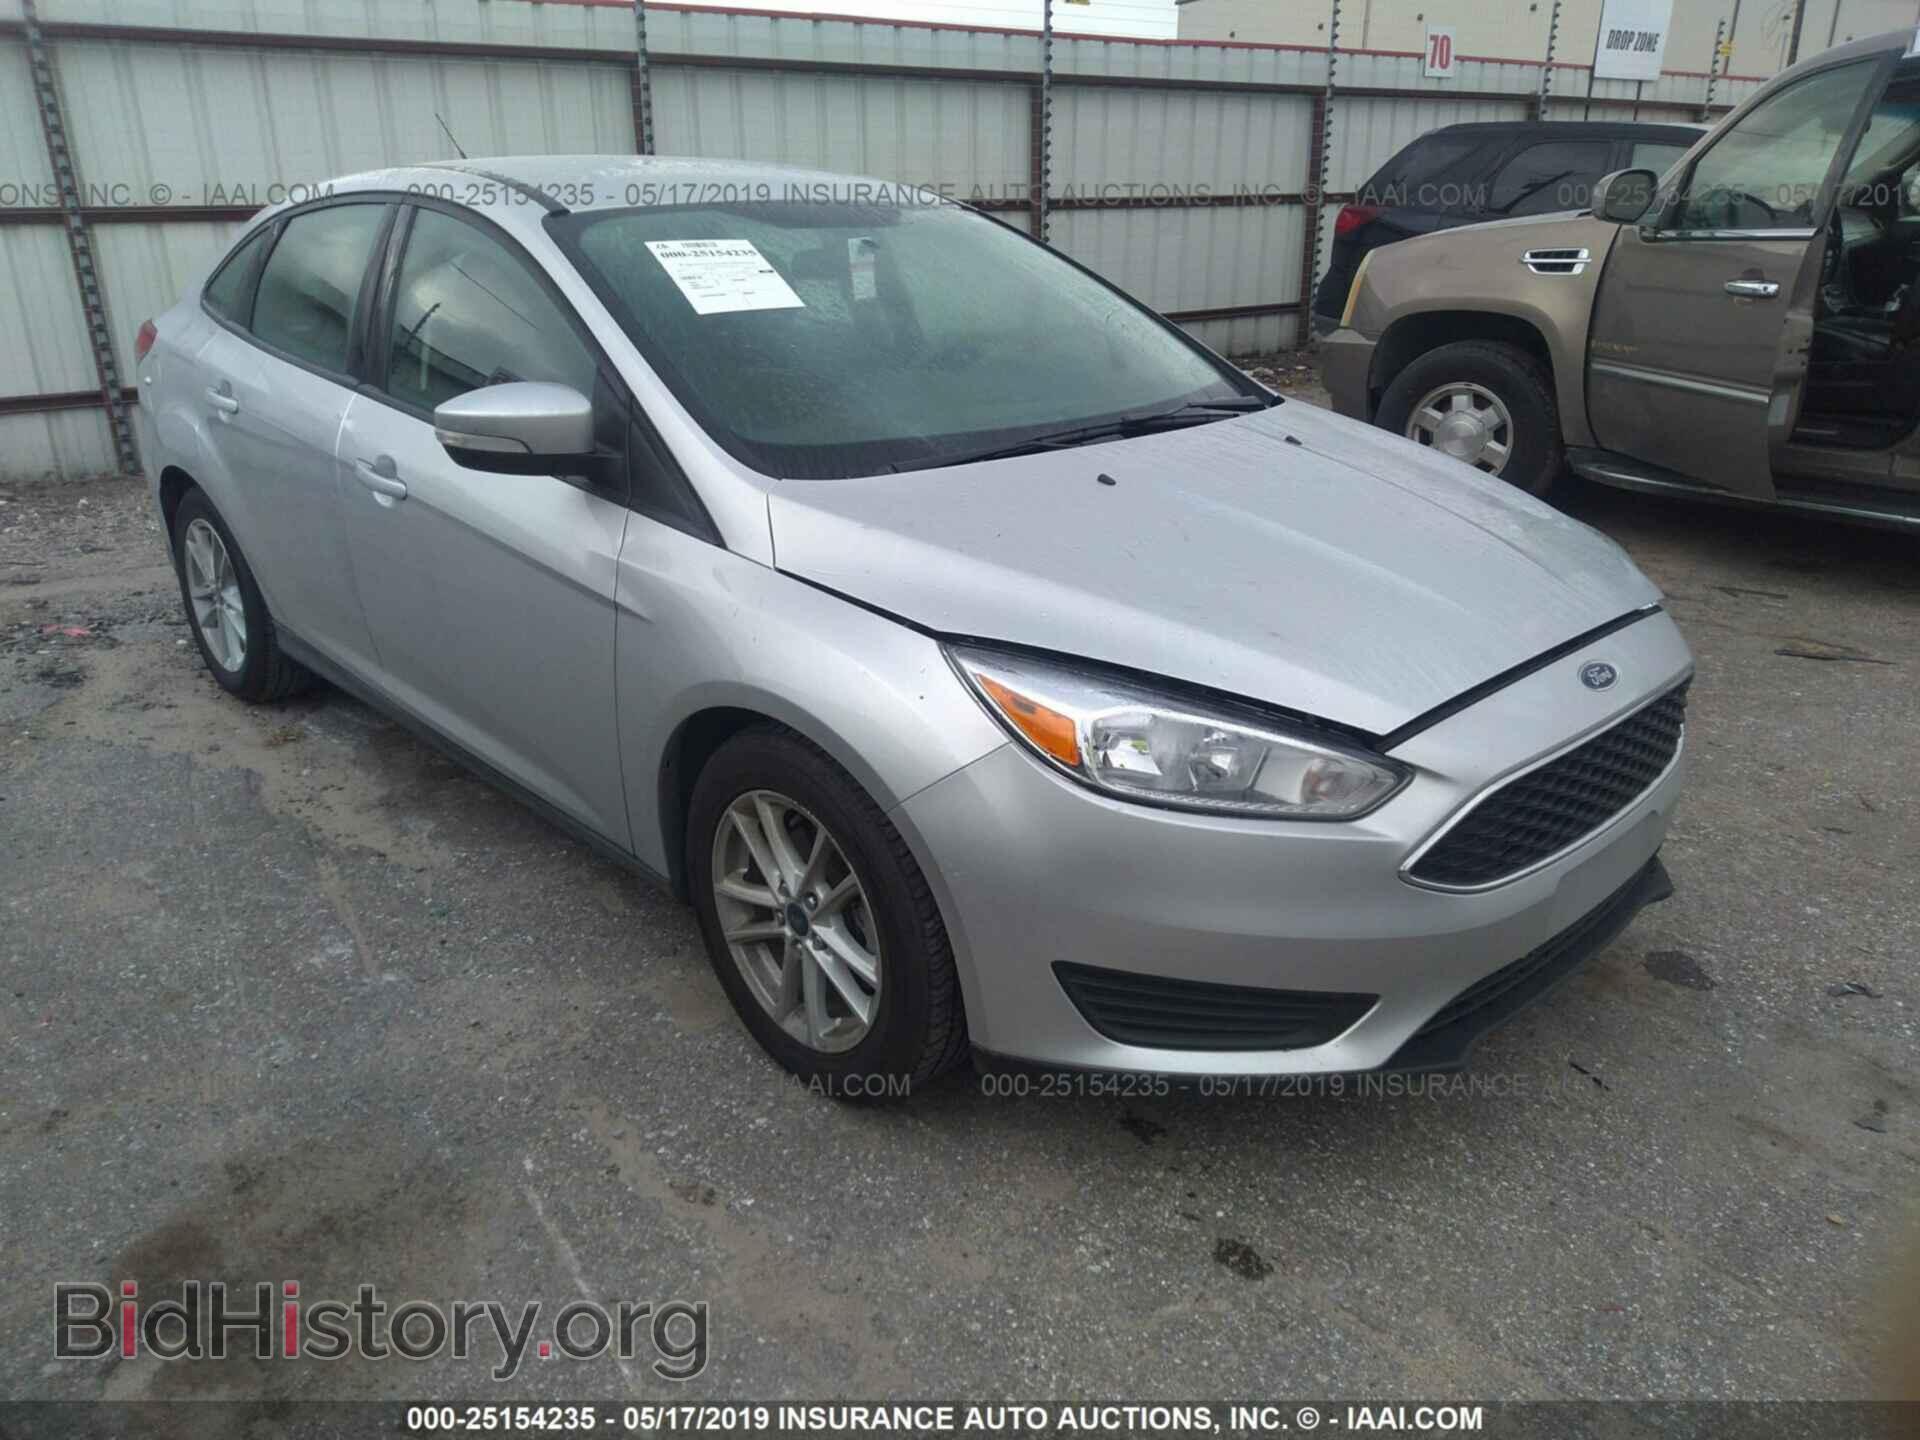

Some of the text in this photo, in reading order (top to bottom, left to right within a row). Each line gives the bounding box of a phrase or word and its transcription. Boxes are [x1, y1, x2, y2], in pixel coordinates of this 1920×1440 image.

[1429, 34, 1452, 70] 70
[1606, 28, 1661, 53] DROP ZONE
